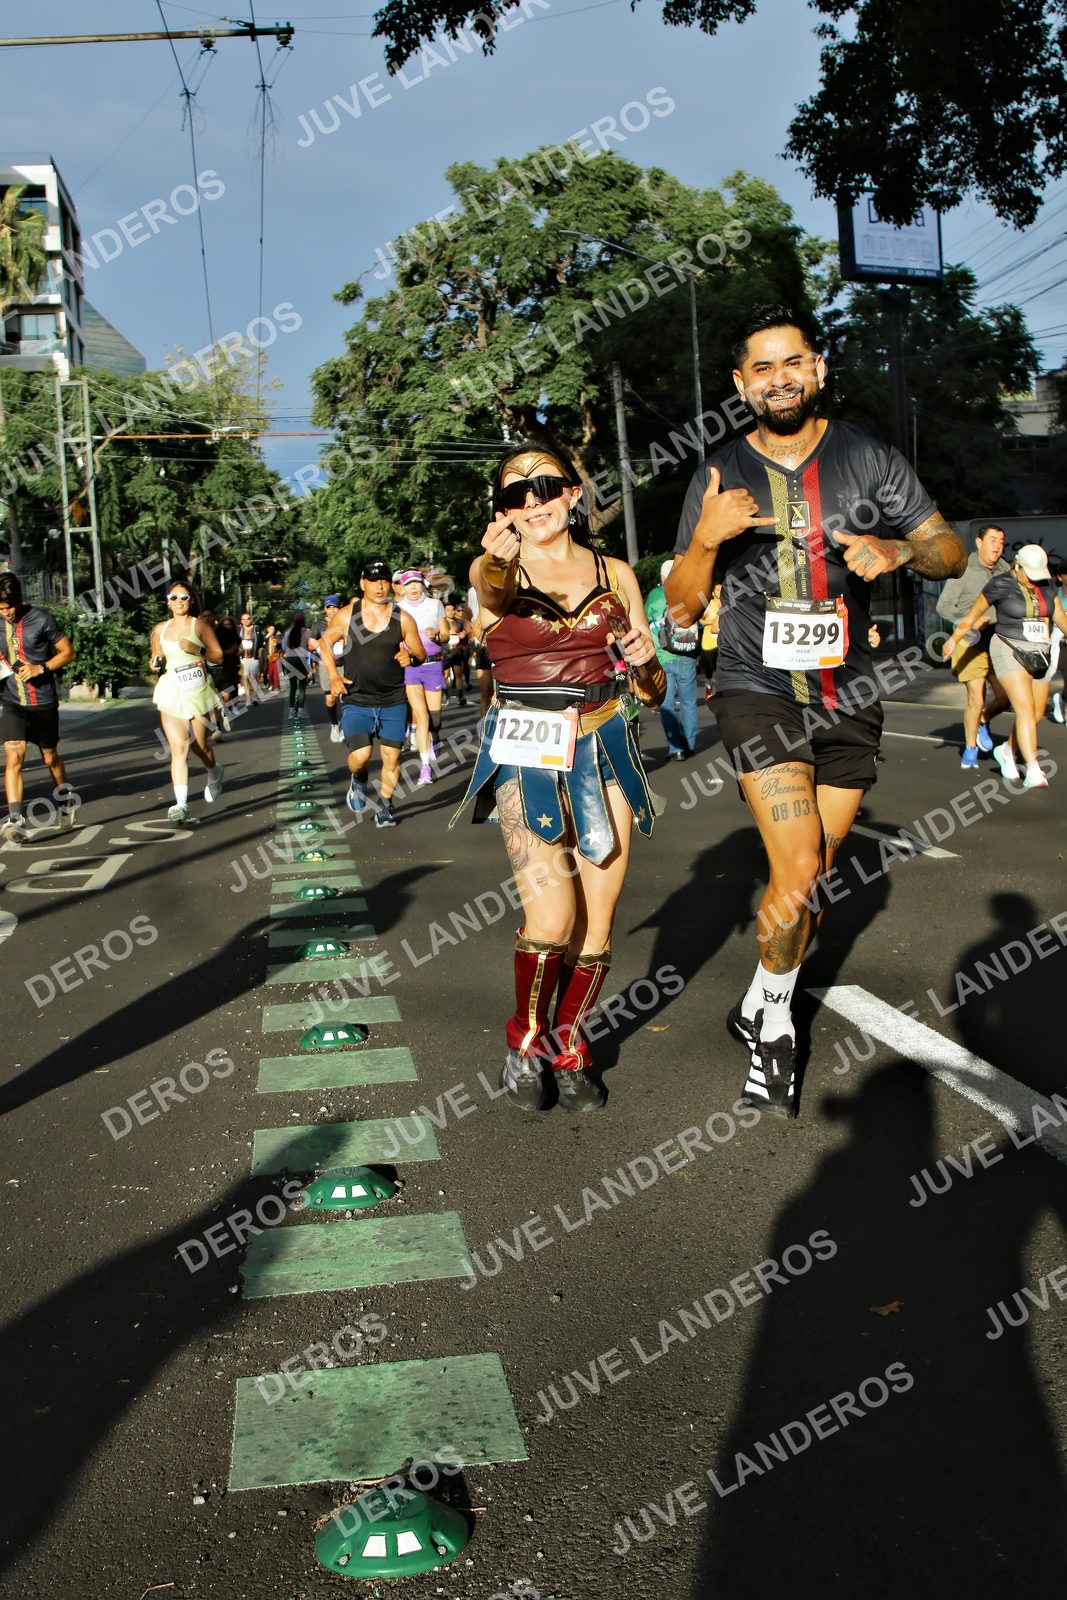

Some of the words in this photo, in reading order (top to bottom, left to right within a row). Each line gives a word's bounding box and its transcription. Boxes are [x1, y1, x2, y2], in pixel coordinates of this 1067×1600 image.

[769, 621, 840, 646] 13299
[178, 669, 203, 683] 10240
[498, 717, 562, 745] 12201
